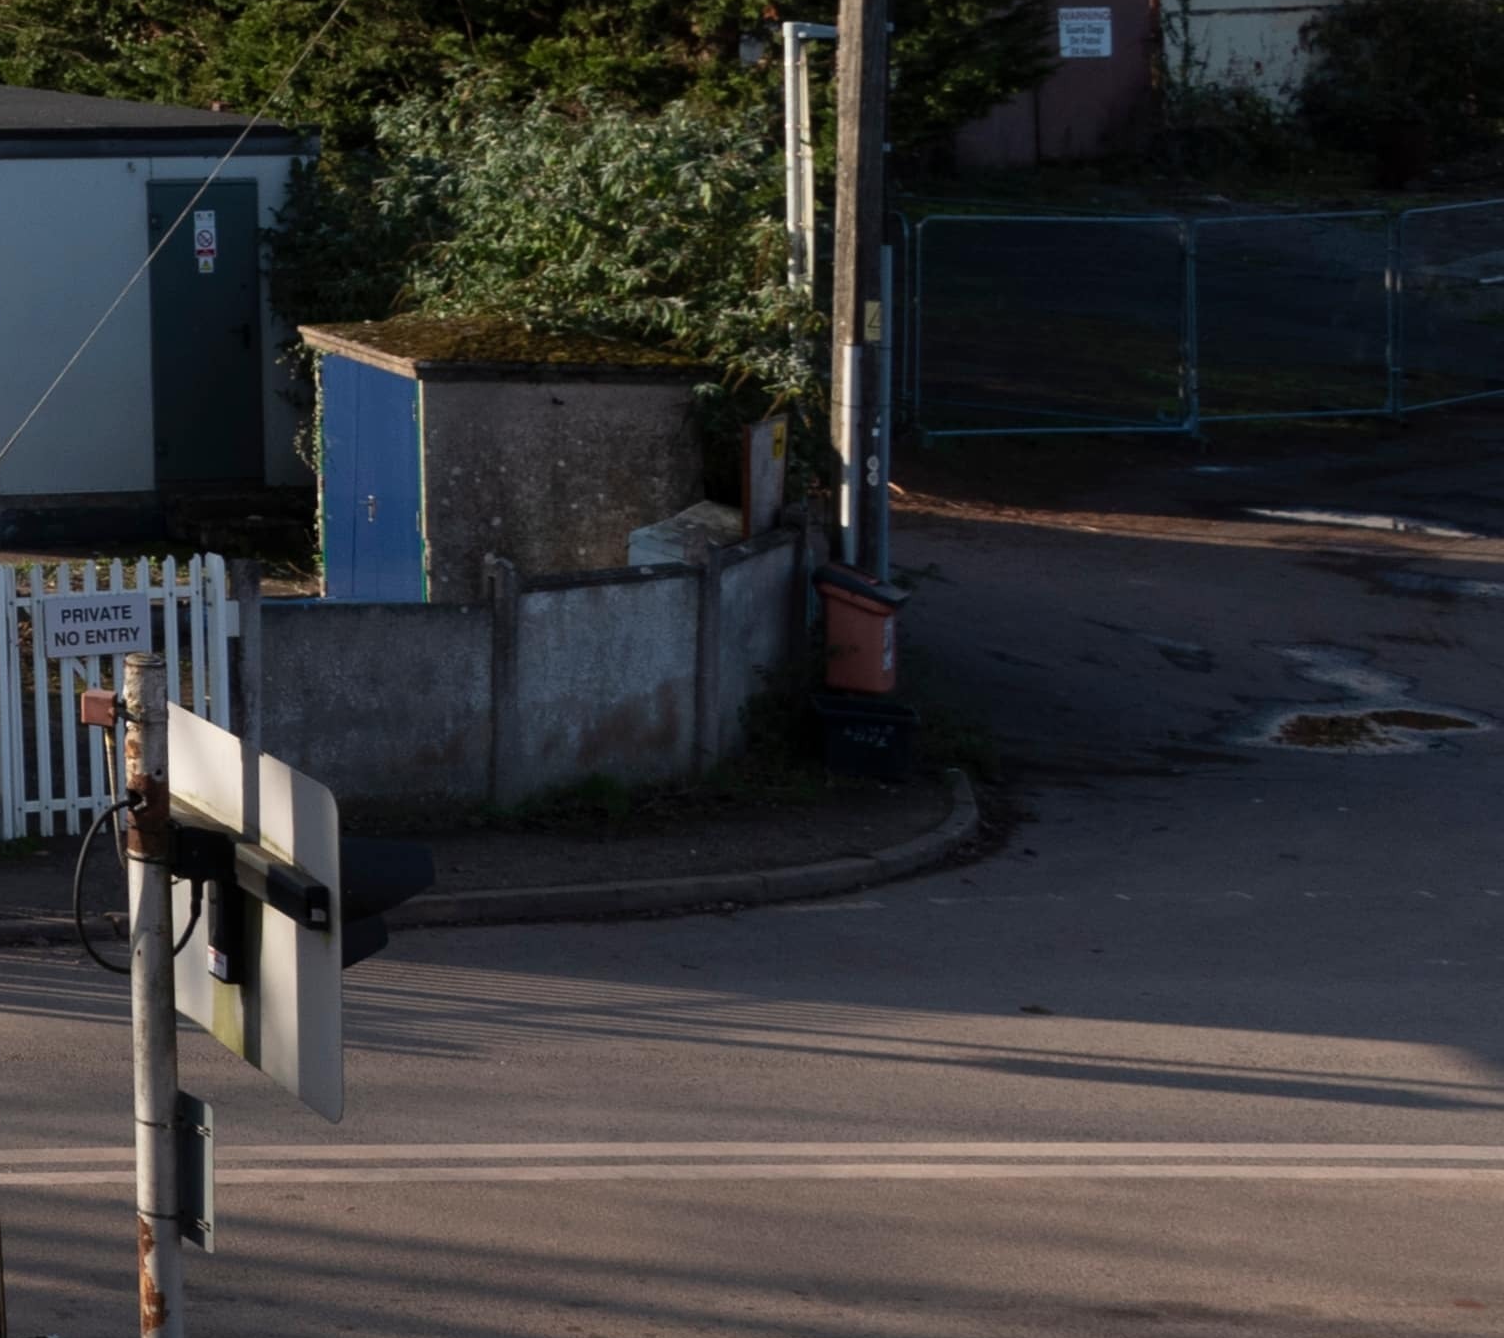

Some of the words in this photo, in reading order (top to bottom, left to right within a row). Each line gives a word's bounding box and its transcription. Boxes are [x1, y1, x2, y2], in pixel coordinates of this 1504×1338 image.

[61, 604, 132, 624] PRIVATE
[55, 631, 80, 646] NO
[85, 626, 141, 645] ENTRY
